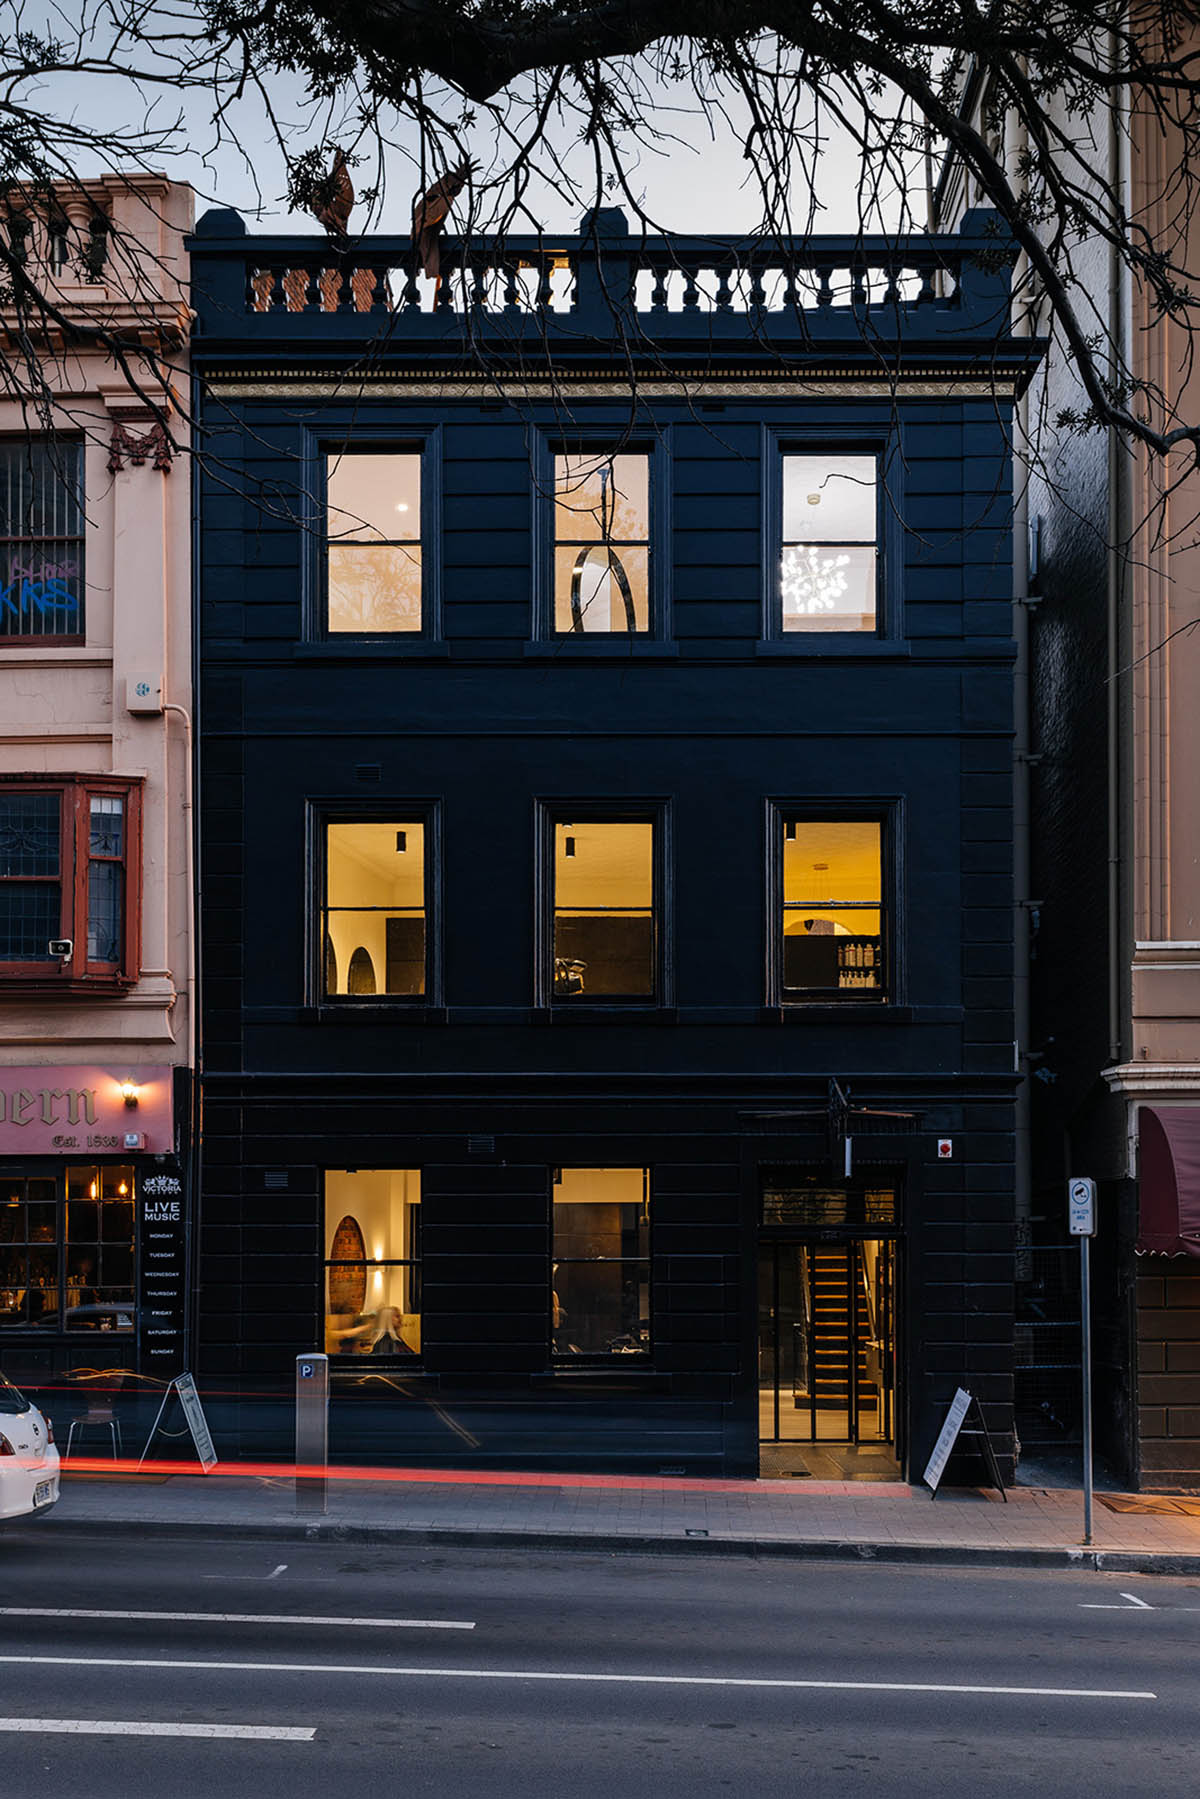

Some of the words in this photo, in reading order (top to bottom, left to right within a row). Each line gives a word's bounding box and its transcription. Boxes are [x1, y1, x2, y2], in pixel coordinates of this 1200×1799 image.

[0, 1088, 99, 1127] ern
[144, 1202, 180, 1212] LIVE
[144, 1213, 180, 1221] MUSIC
[302, 1365, 311, 1377] P
